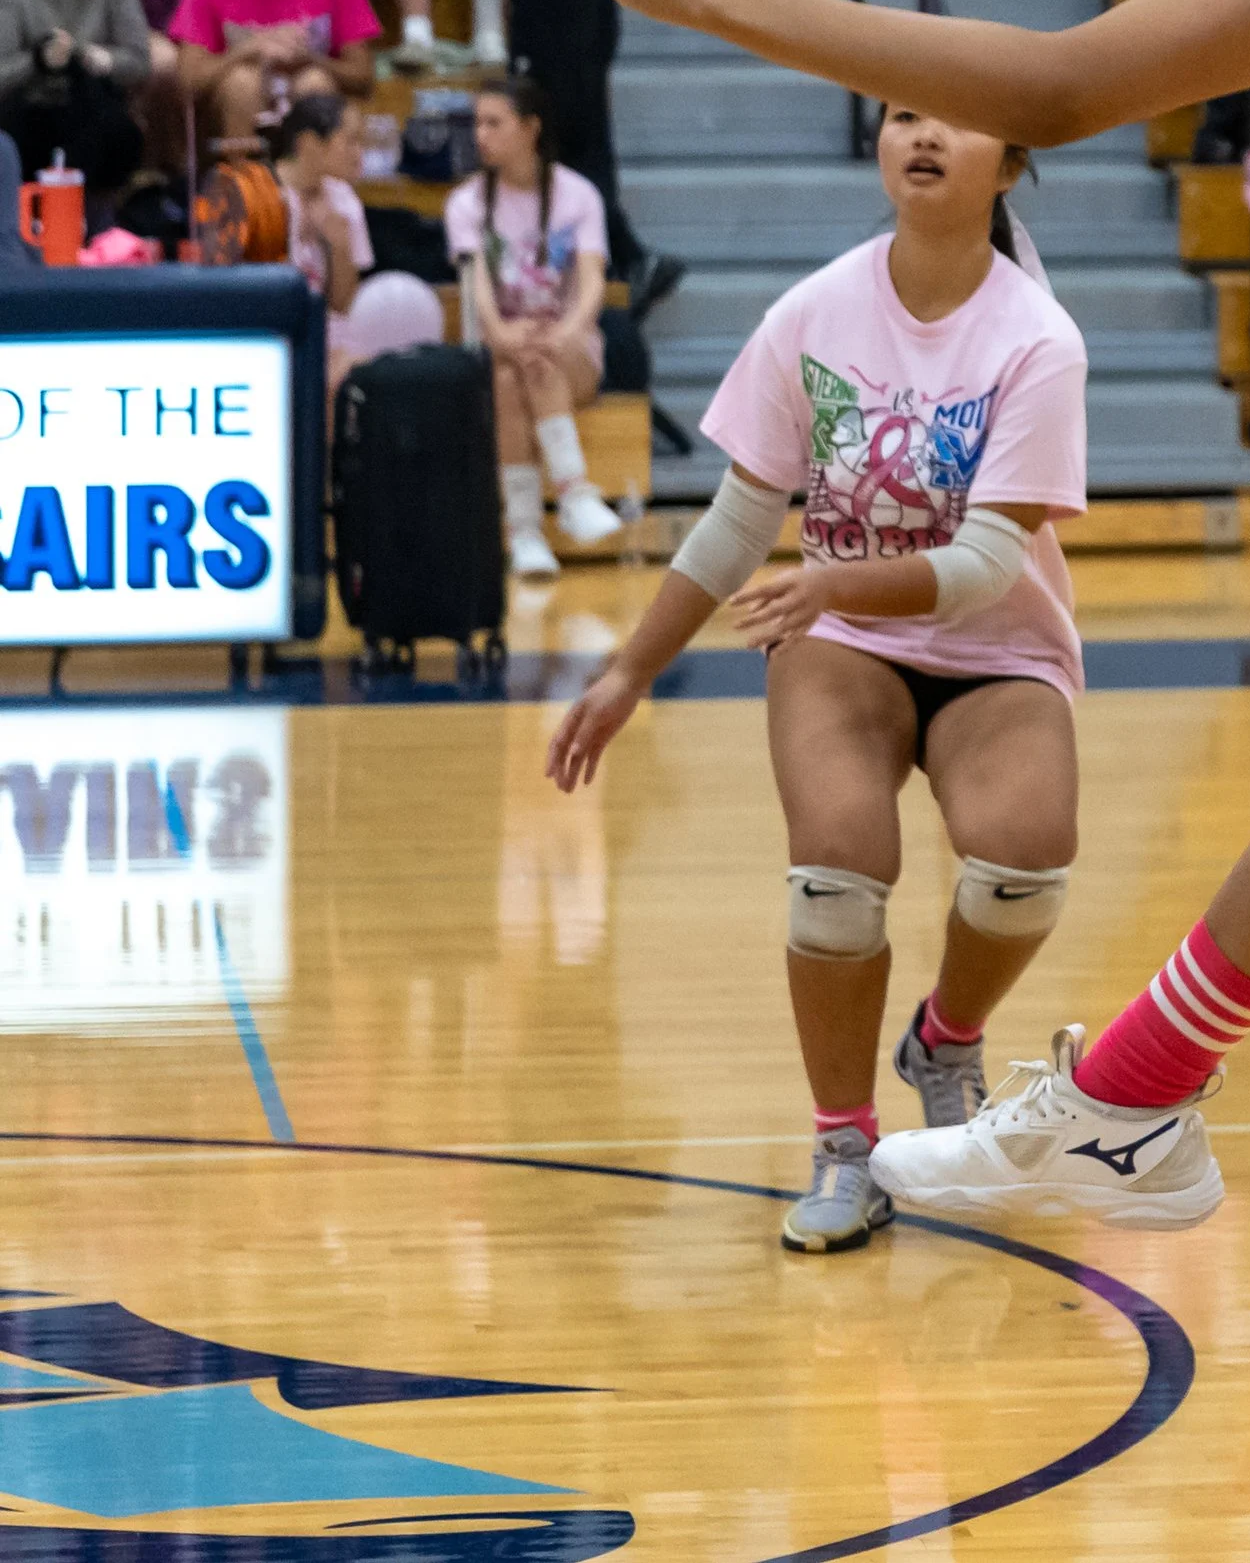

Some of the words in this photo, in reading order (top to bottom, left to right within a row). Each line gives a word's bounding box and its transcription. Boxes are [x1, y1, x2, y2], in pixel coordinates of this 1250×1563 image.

[104, 383, 253, 438] THE
[934, 385, 999, 430] MOT
[0, 479, 273, 591] AIRS
